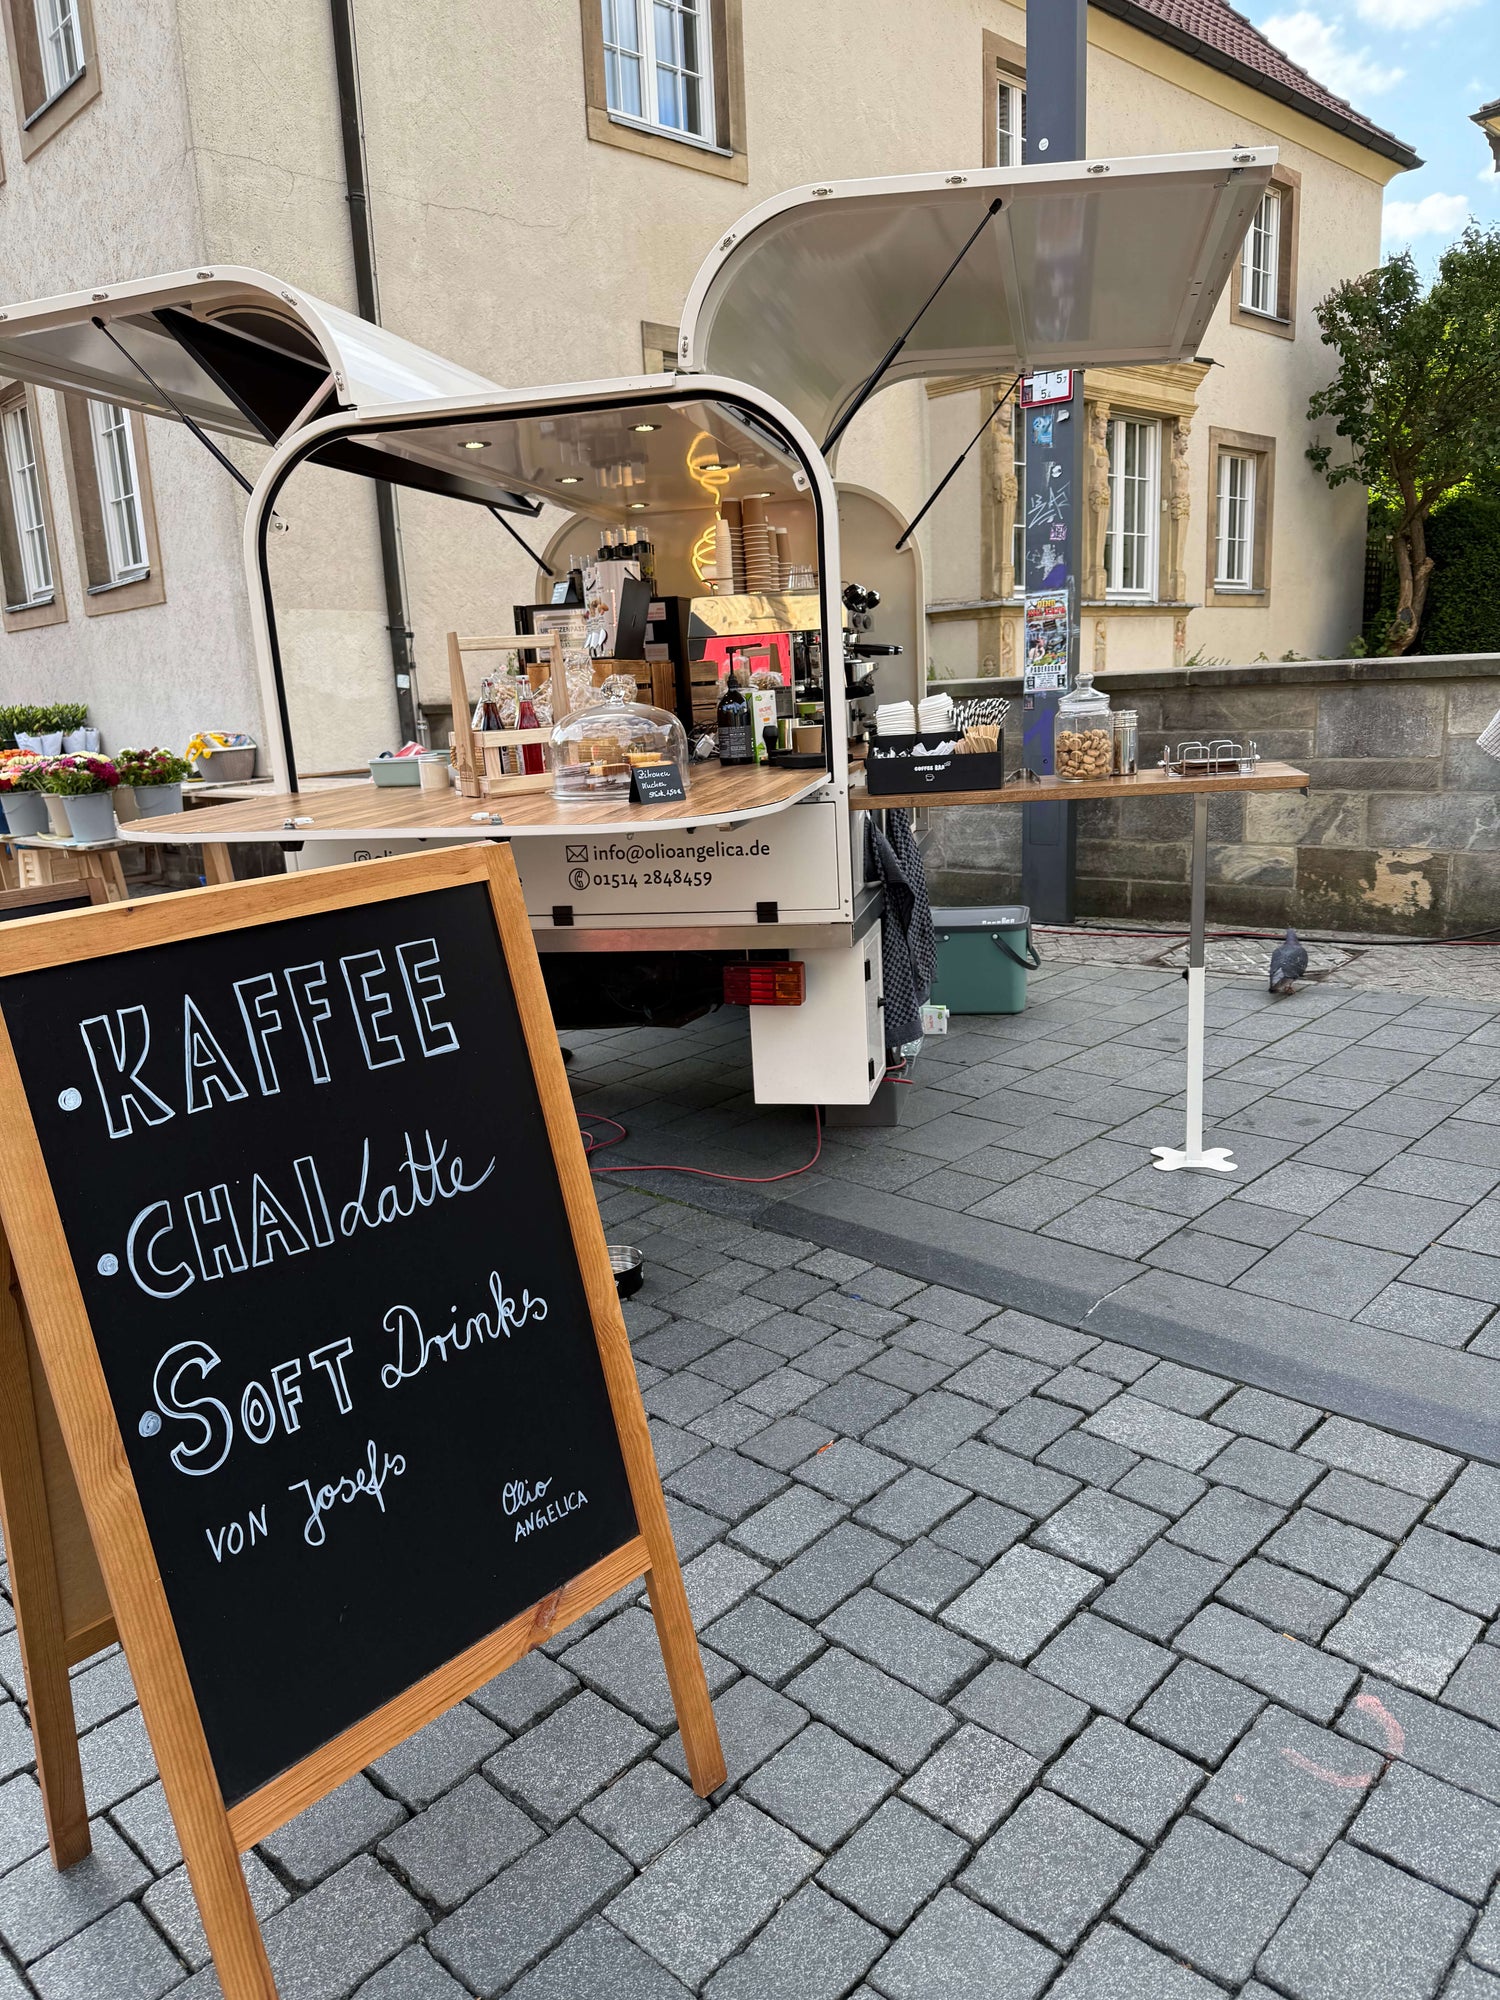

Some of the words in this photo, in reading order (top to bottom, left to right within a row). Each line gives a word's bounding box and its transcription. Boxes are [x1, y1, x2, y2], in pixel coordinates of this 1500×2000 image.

[593, 839, 771, 864] info@olioangelica.de
[593, 873, 638, 889] 01514
[643, 869, 713, 887] 2848459
[79, 937, 460, 1140] KAFFEE
[126, 1155, 335, 1299] CHAI
[339, 1129, 496, 1237] Latte
[153, 1338, 353, 1476] SOFT
[381, 1270, 548, 1389] Drinks
[502, 1476, 553, 1516] Olio
[514, 1490, 589, 1543] ANGELICA
